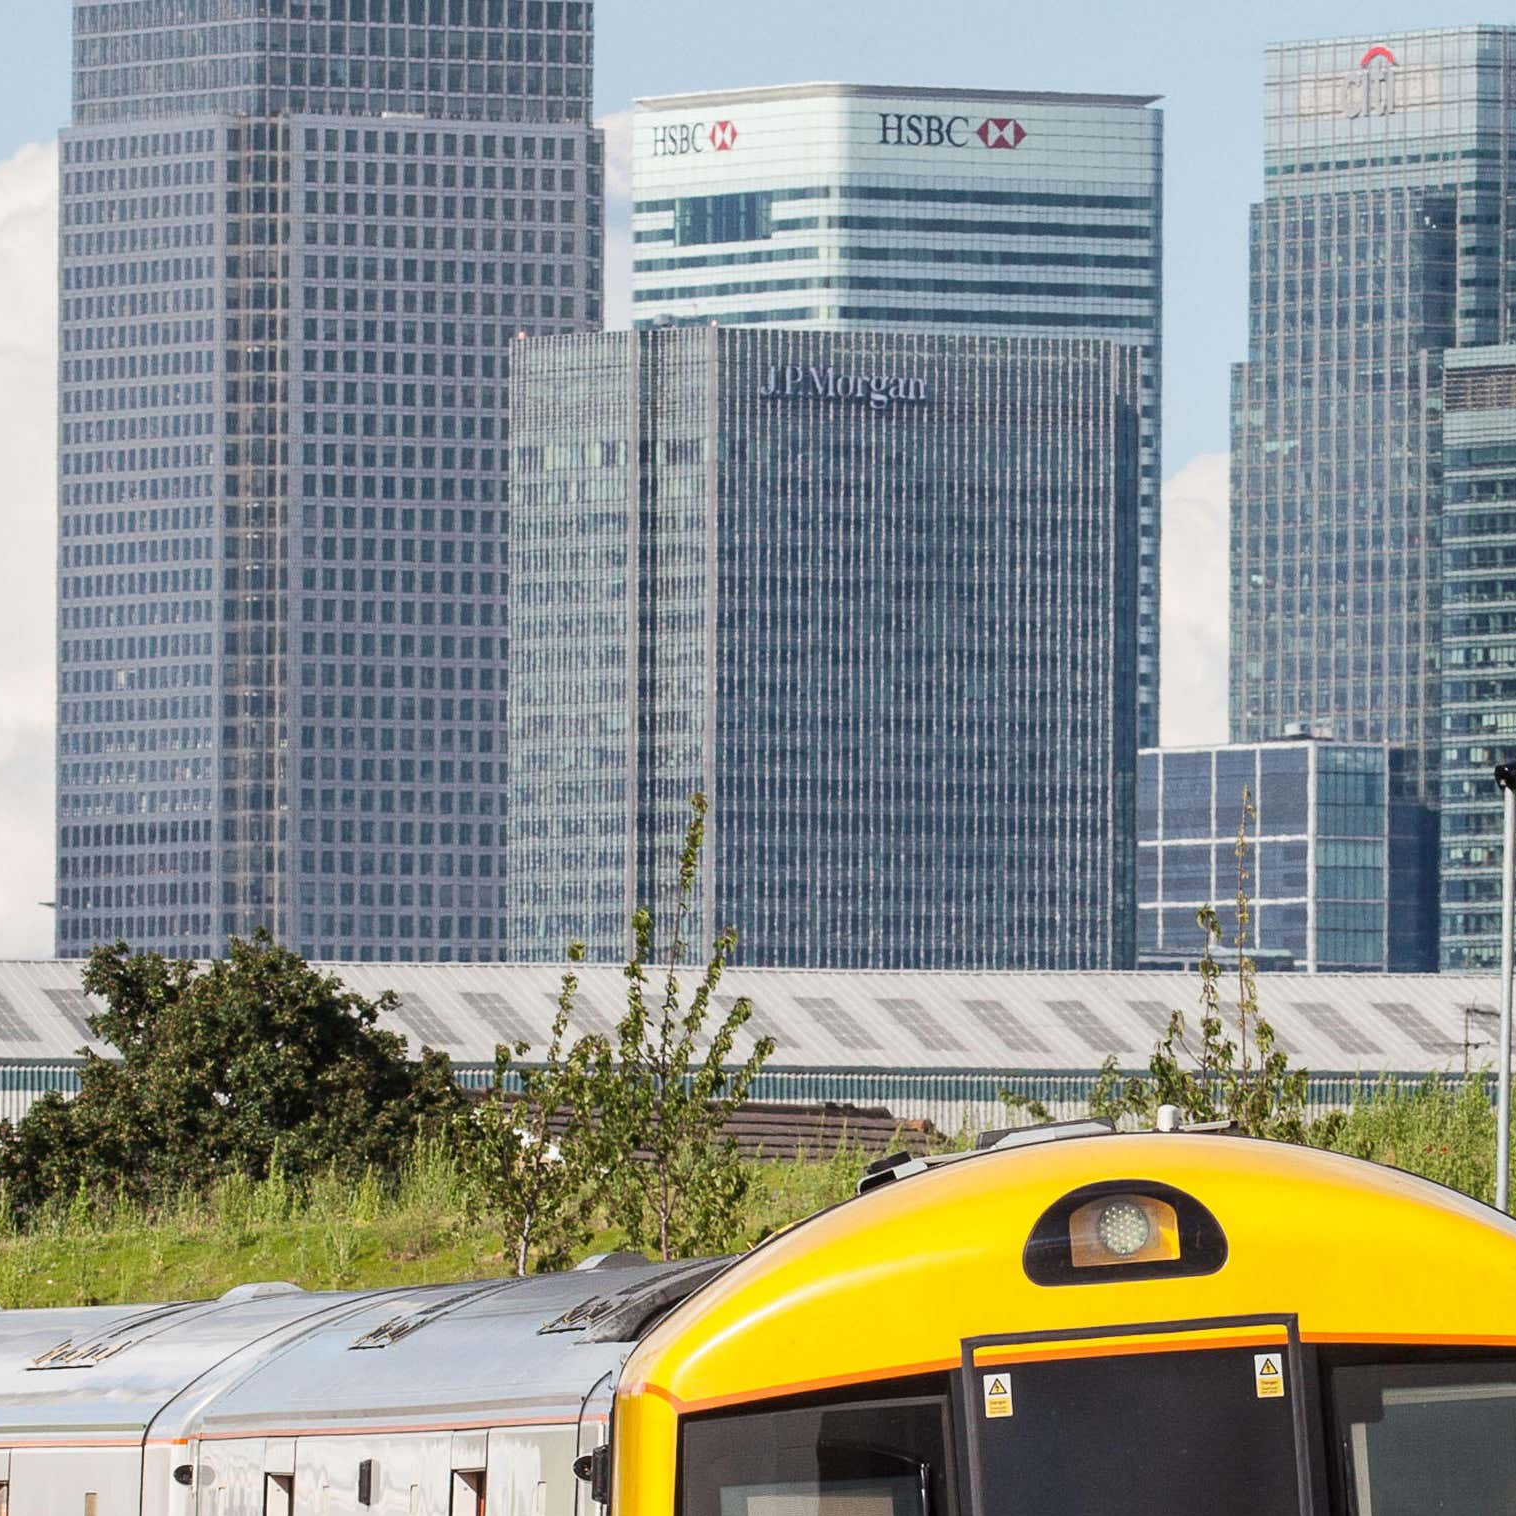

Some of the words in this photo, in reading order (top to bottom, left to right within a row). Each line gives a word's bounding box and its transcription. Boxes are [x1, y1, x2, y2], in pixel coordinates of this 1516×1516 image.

[1346, 57, 1395, 118] citi
[653, 122, 705, 156] HSBC
[880, 113, 969, 147] HSBC
